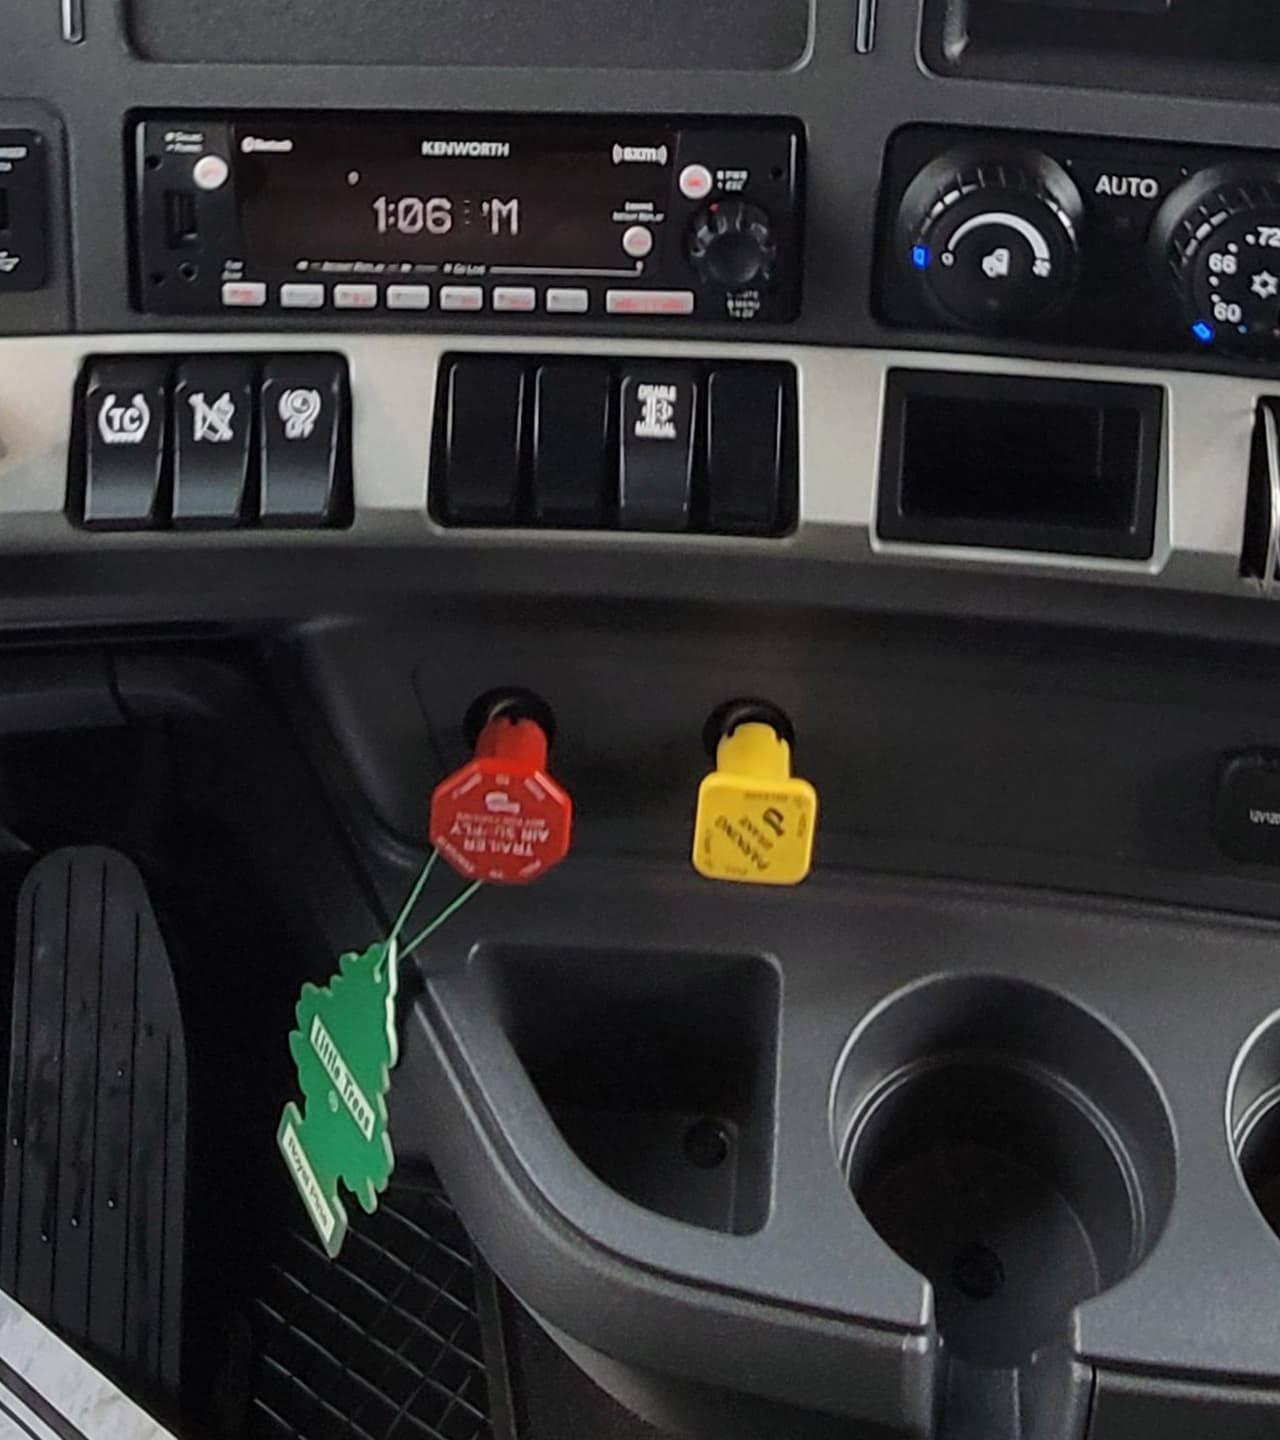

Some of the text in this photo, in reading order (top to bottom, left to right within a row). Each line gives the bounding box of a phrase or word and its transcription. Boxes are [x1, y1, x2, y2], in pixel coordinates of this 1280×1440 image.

[421, 140, 509, 158] KENWORTH
[1095, 173, 1159, 198] AUTO
[372, 195, 453, 235] 1:06
[1208, 253, 1237, 274] 66
[1213, 302, 1242, 323] 60
[108, 408, 141, 432] TC
[521, 827, 551, 843] AIR
[464, 839, 534, 857] TRAILER
[313, 1023, 373, 1132] Little Trees
